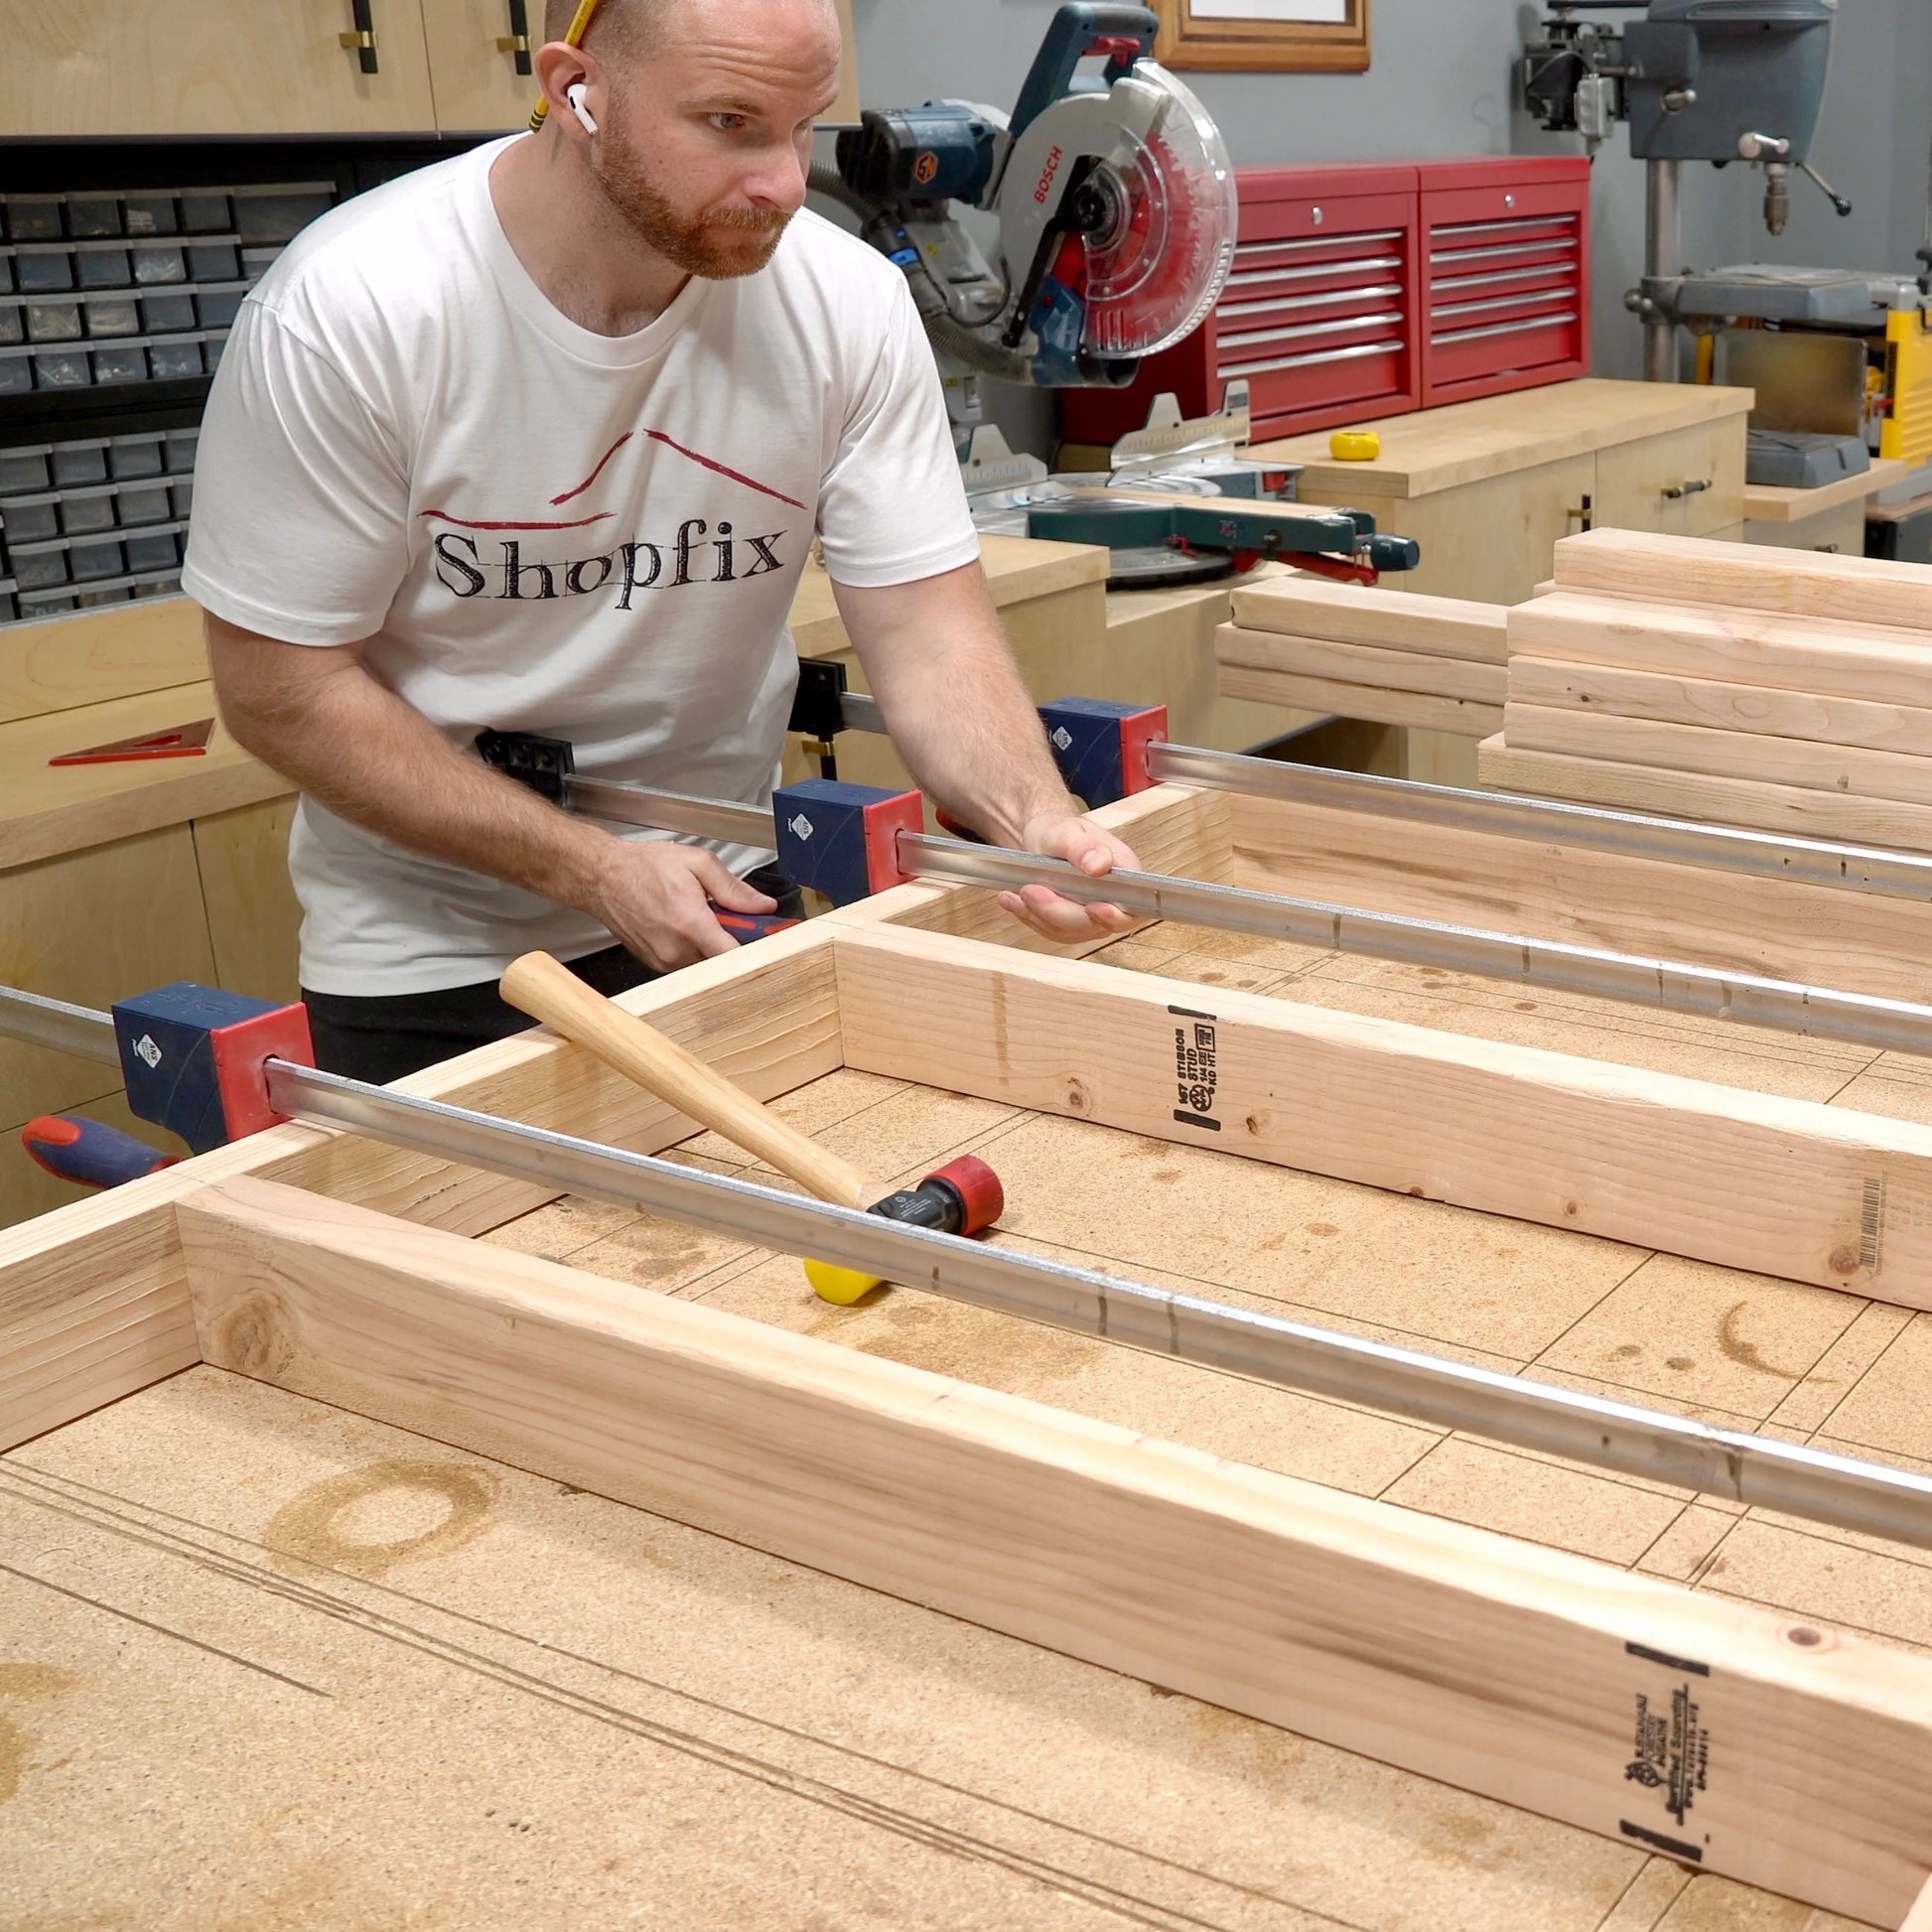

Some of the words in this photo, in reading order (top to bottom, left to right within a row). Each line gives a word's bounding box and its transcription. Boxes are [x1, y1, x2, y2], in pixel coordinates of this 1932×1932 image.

[1034, 145, 1062, 206] BOSCH
[434, 519, 787, 610] Shopfix
[1186, 1048, 1198, 1081] STUD
